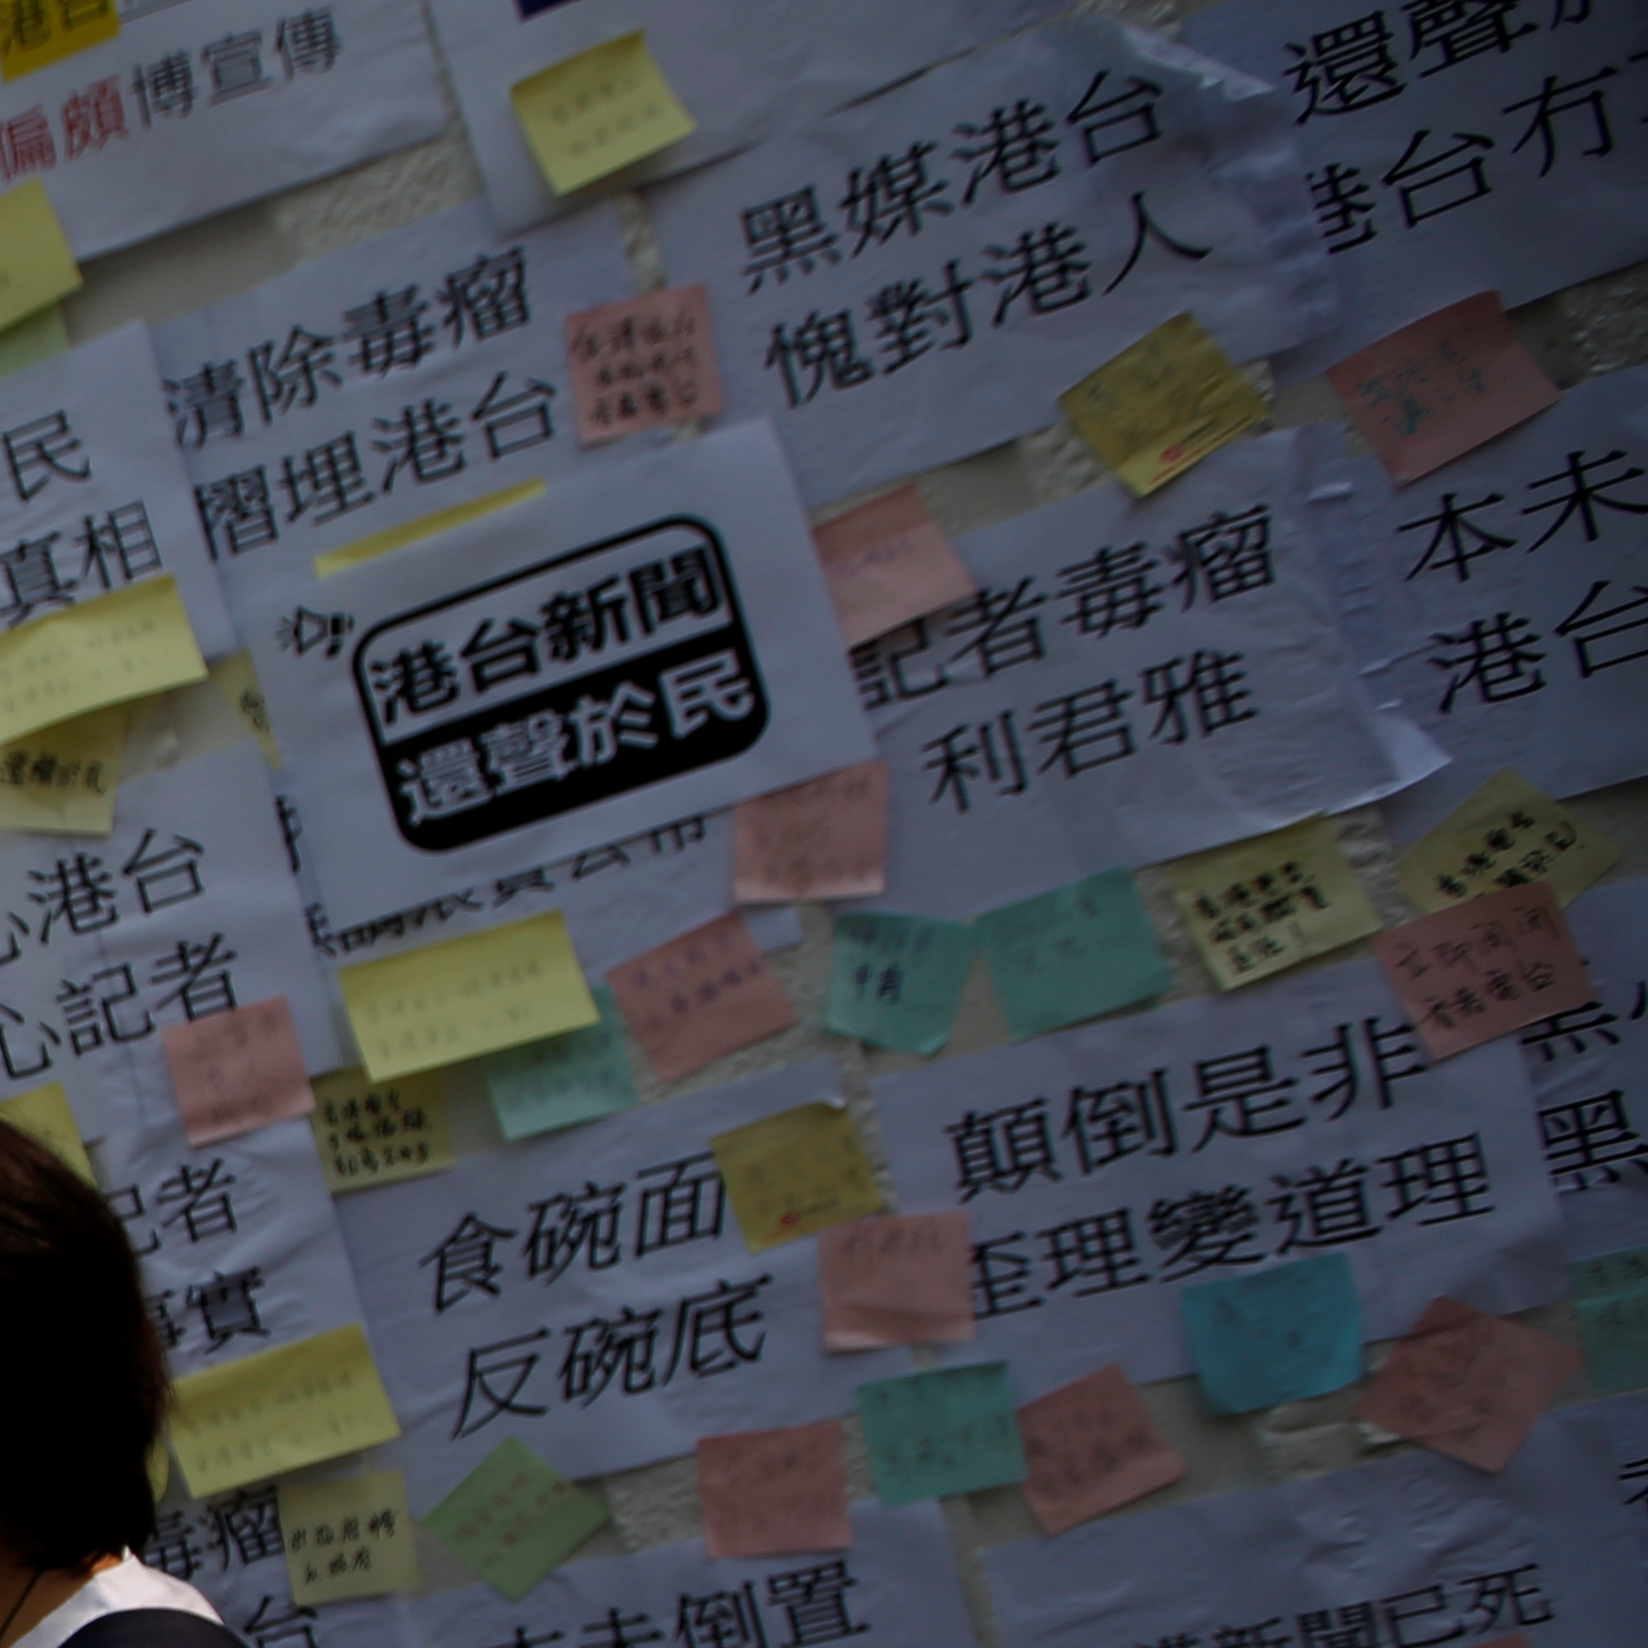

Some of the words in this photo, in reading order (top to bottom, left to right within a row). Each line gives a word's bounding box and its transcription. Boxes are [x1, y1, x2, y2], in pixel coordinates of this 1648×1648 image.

[1283, 0, 1595, 125] 還聲
[1306, 50, 1648, 256] 港台冇
[739, 68, 1164, 296] 黑媒港台
[161, 246, 531, 450] 清除毒瘤
[762, 192, 1213, 409] 愧對港人
[368, 546, 725, 729] 港台新聞
[852, 502, 1275, 711] 記者毒瘤
[395, 647, 757, 825] 還聲於民
[921, 649, 1259, 815] 利君雅
[945, 1015, 1428, 1205] 顛倒是非
[418, 1150, 724, 1313] 食碗面
[970, 1131, 1495, 1321] 歪理變道理
[451, 1273, 773, 1439] 反碗底
[143, 1485, 286, 1580] 毒瘤
